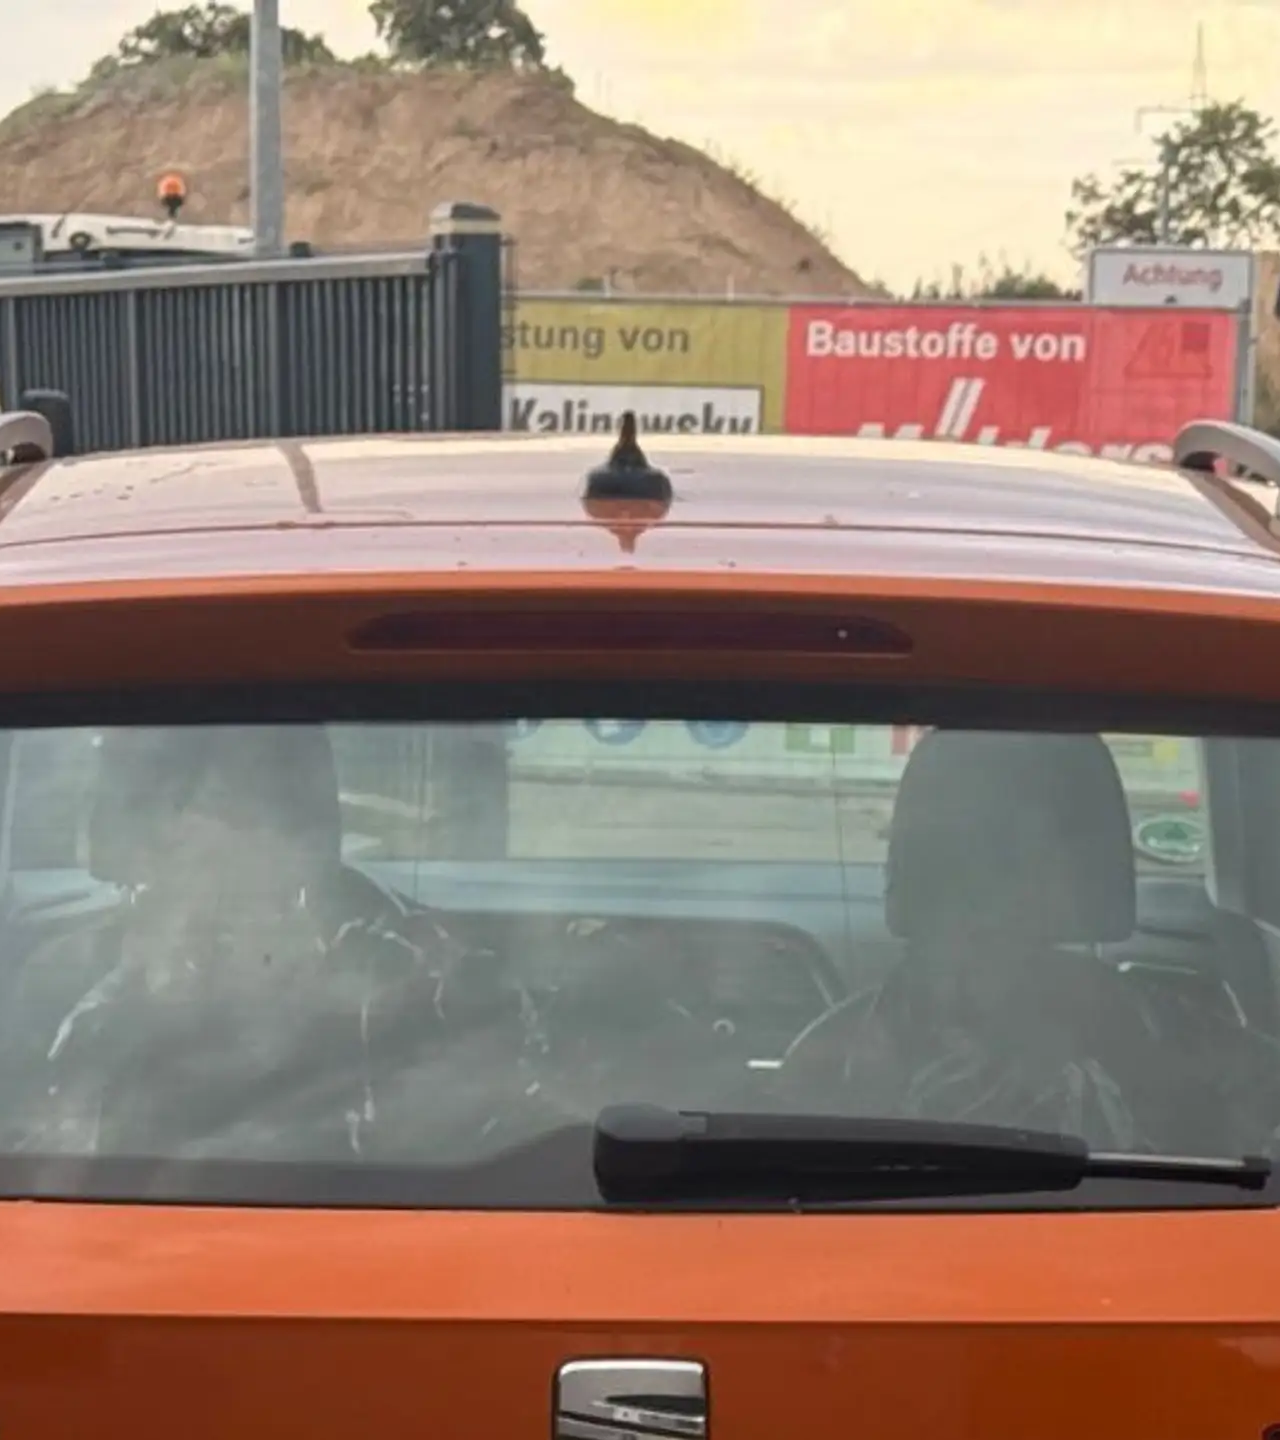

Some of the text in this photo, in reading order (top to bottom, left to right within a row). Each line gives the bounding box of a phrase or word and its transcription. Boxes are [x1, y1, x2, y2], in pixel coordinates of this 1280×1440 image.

[1122, 262, 1224, 293] Achtung
[618, 327, 690, 352] von
[806, 320, 1085, 360] Baustoffe von
